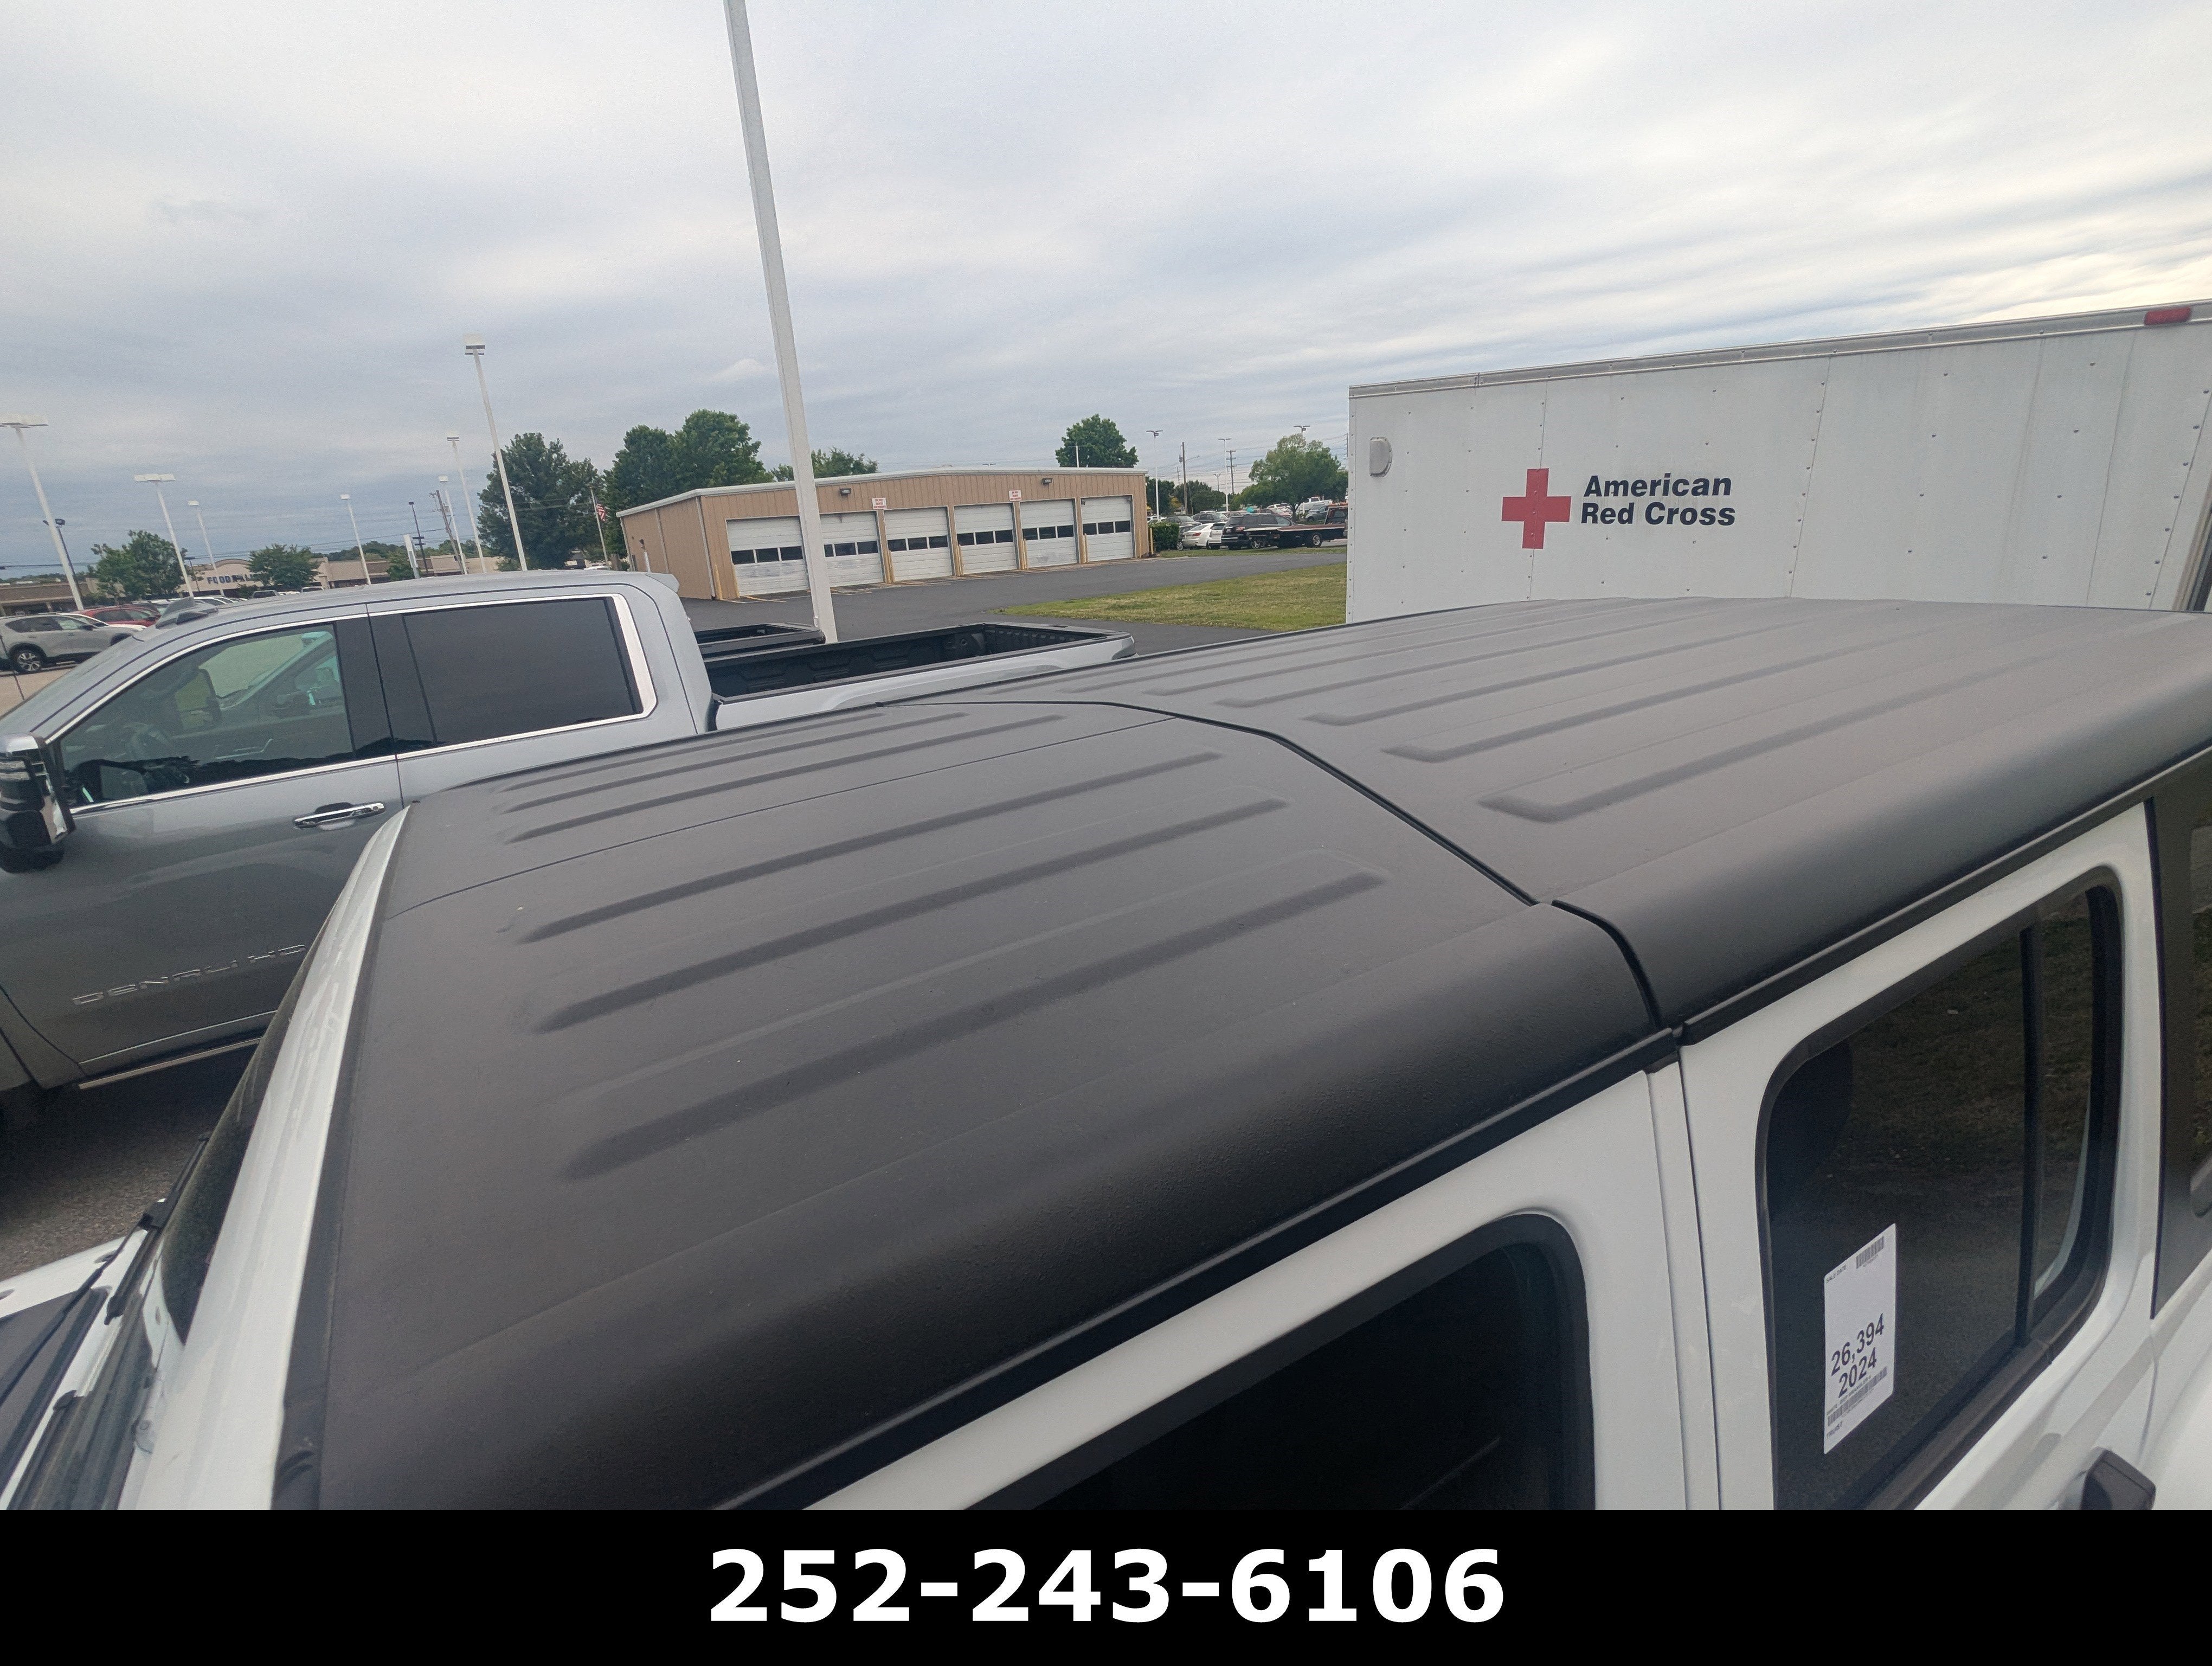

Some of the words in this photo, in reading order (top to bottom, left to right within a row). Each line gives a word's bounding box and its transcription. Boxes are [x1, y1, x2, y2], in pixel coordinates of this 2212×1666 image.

[1583, 472, 1732, 497] American
[1581, 502, 1635, 525] Red
[1644, 502, 1735, 526] Cross
[207, 575, 232, 584] FOOD
[1831, 1312, 1885, 1376] 26,394
[1838, 1347, 1877, 1399] 2024
